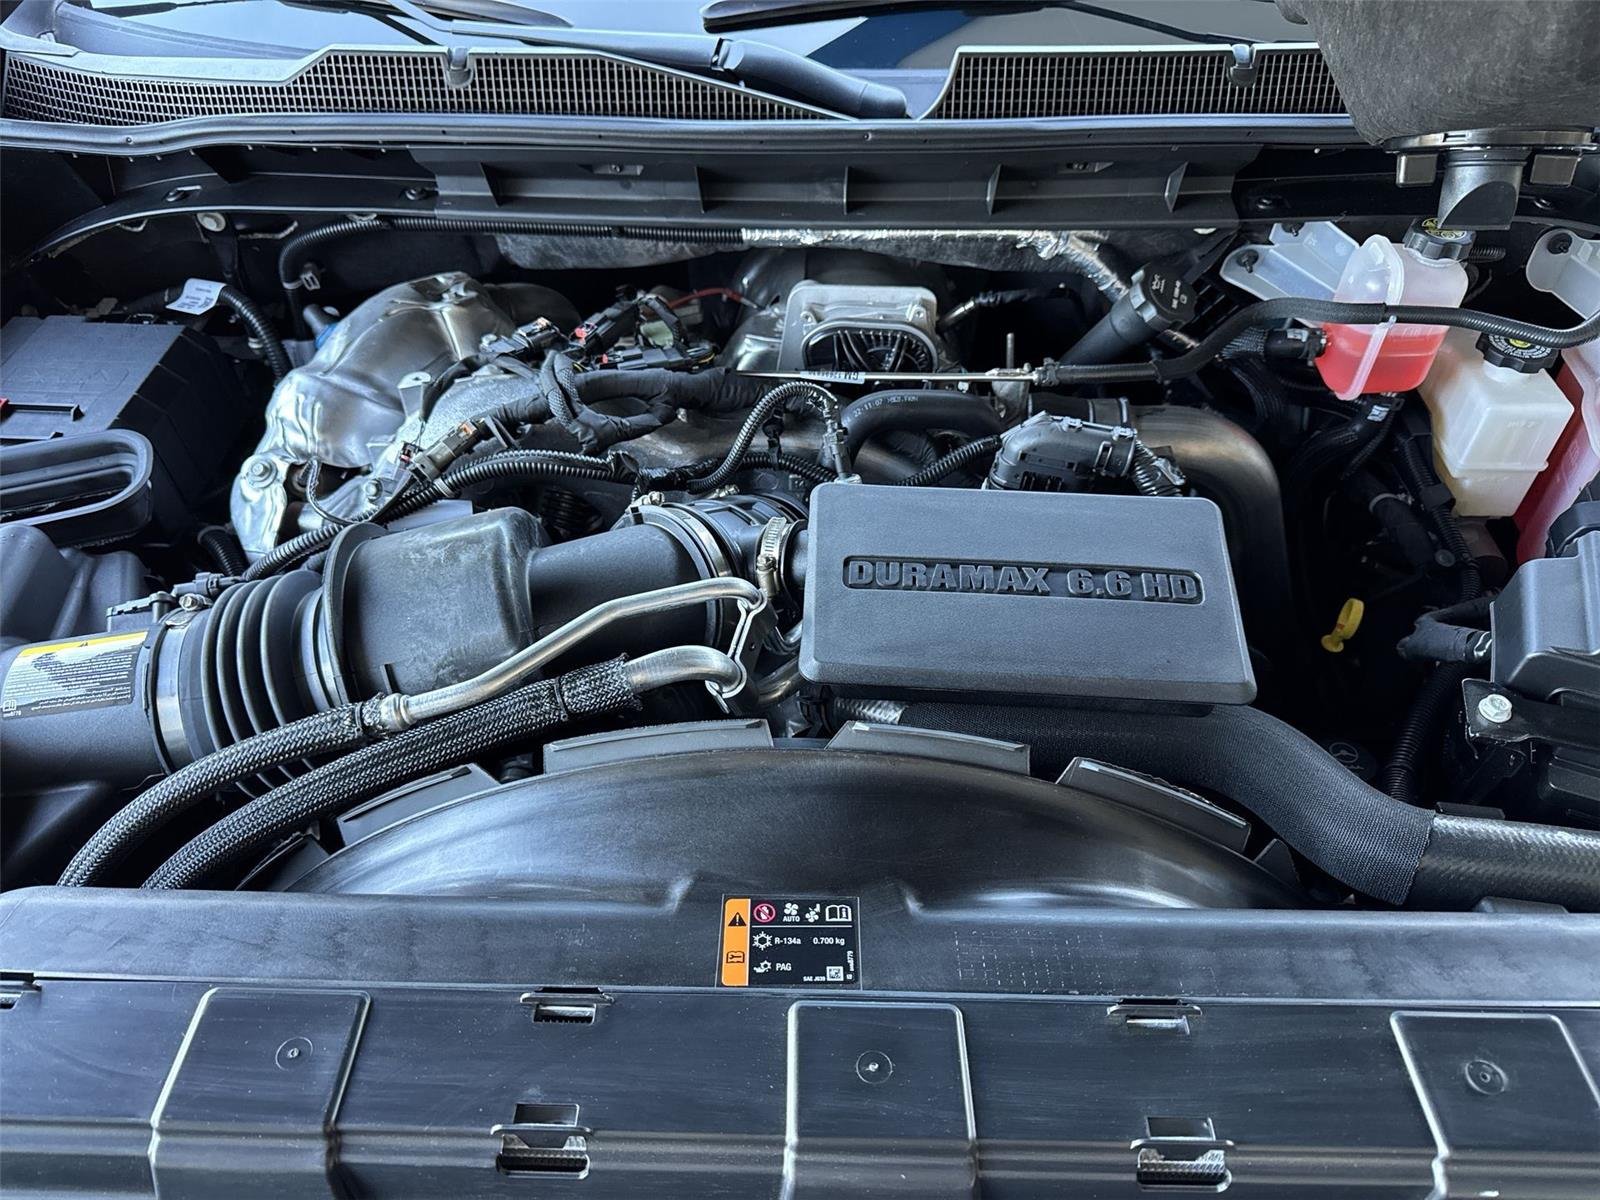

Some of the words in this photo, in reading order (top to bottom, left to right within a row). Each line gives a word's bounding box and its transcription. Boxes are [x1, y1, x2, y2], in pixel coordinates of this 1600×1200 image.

[848, 559, 1051, 593] DURAMAX
[1066, 568, 1133, 597] 6.6
[1140, 572, 1199, 600] HD
[774, 937, 802, 945] R-134a
[812, 937, 834, 945] 0.700
[835, 937, 846, 946] kg
[775, 963, 792, 971] PAG
